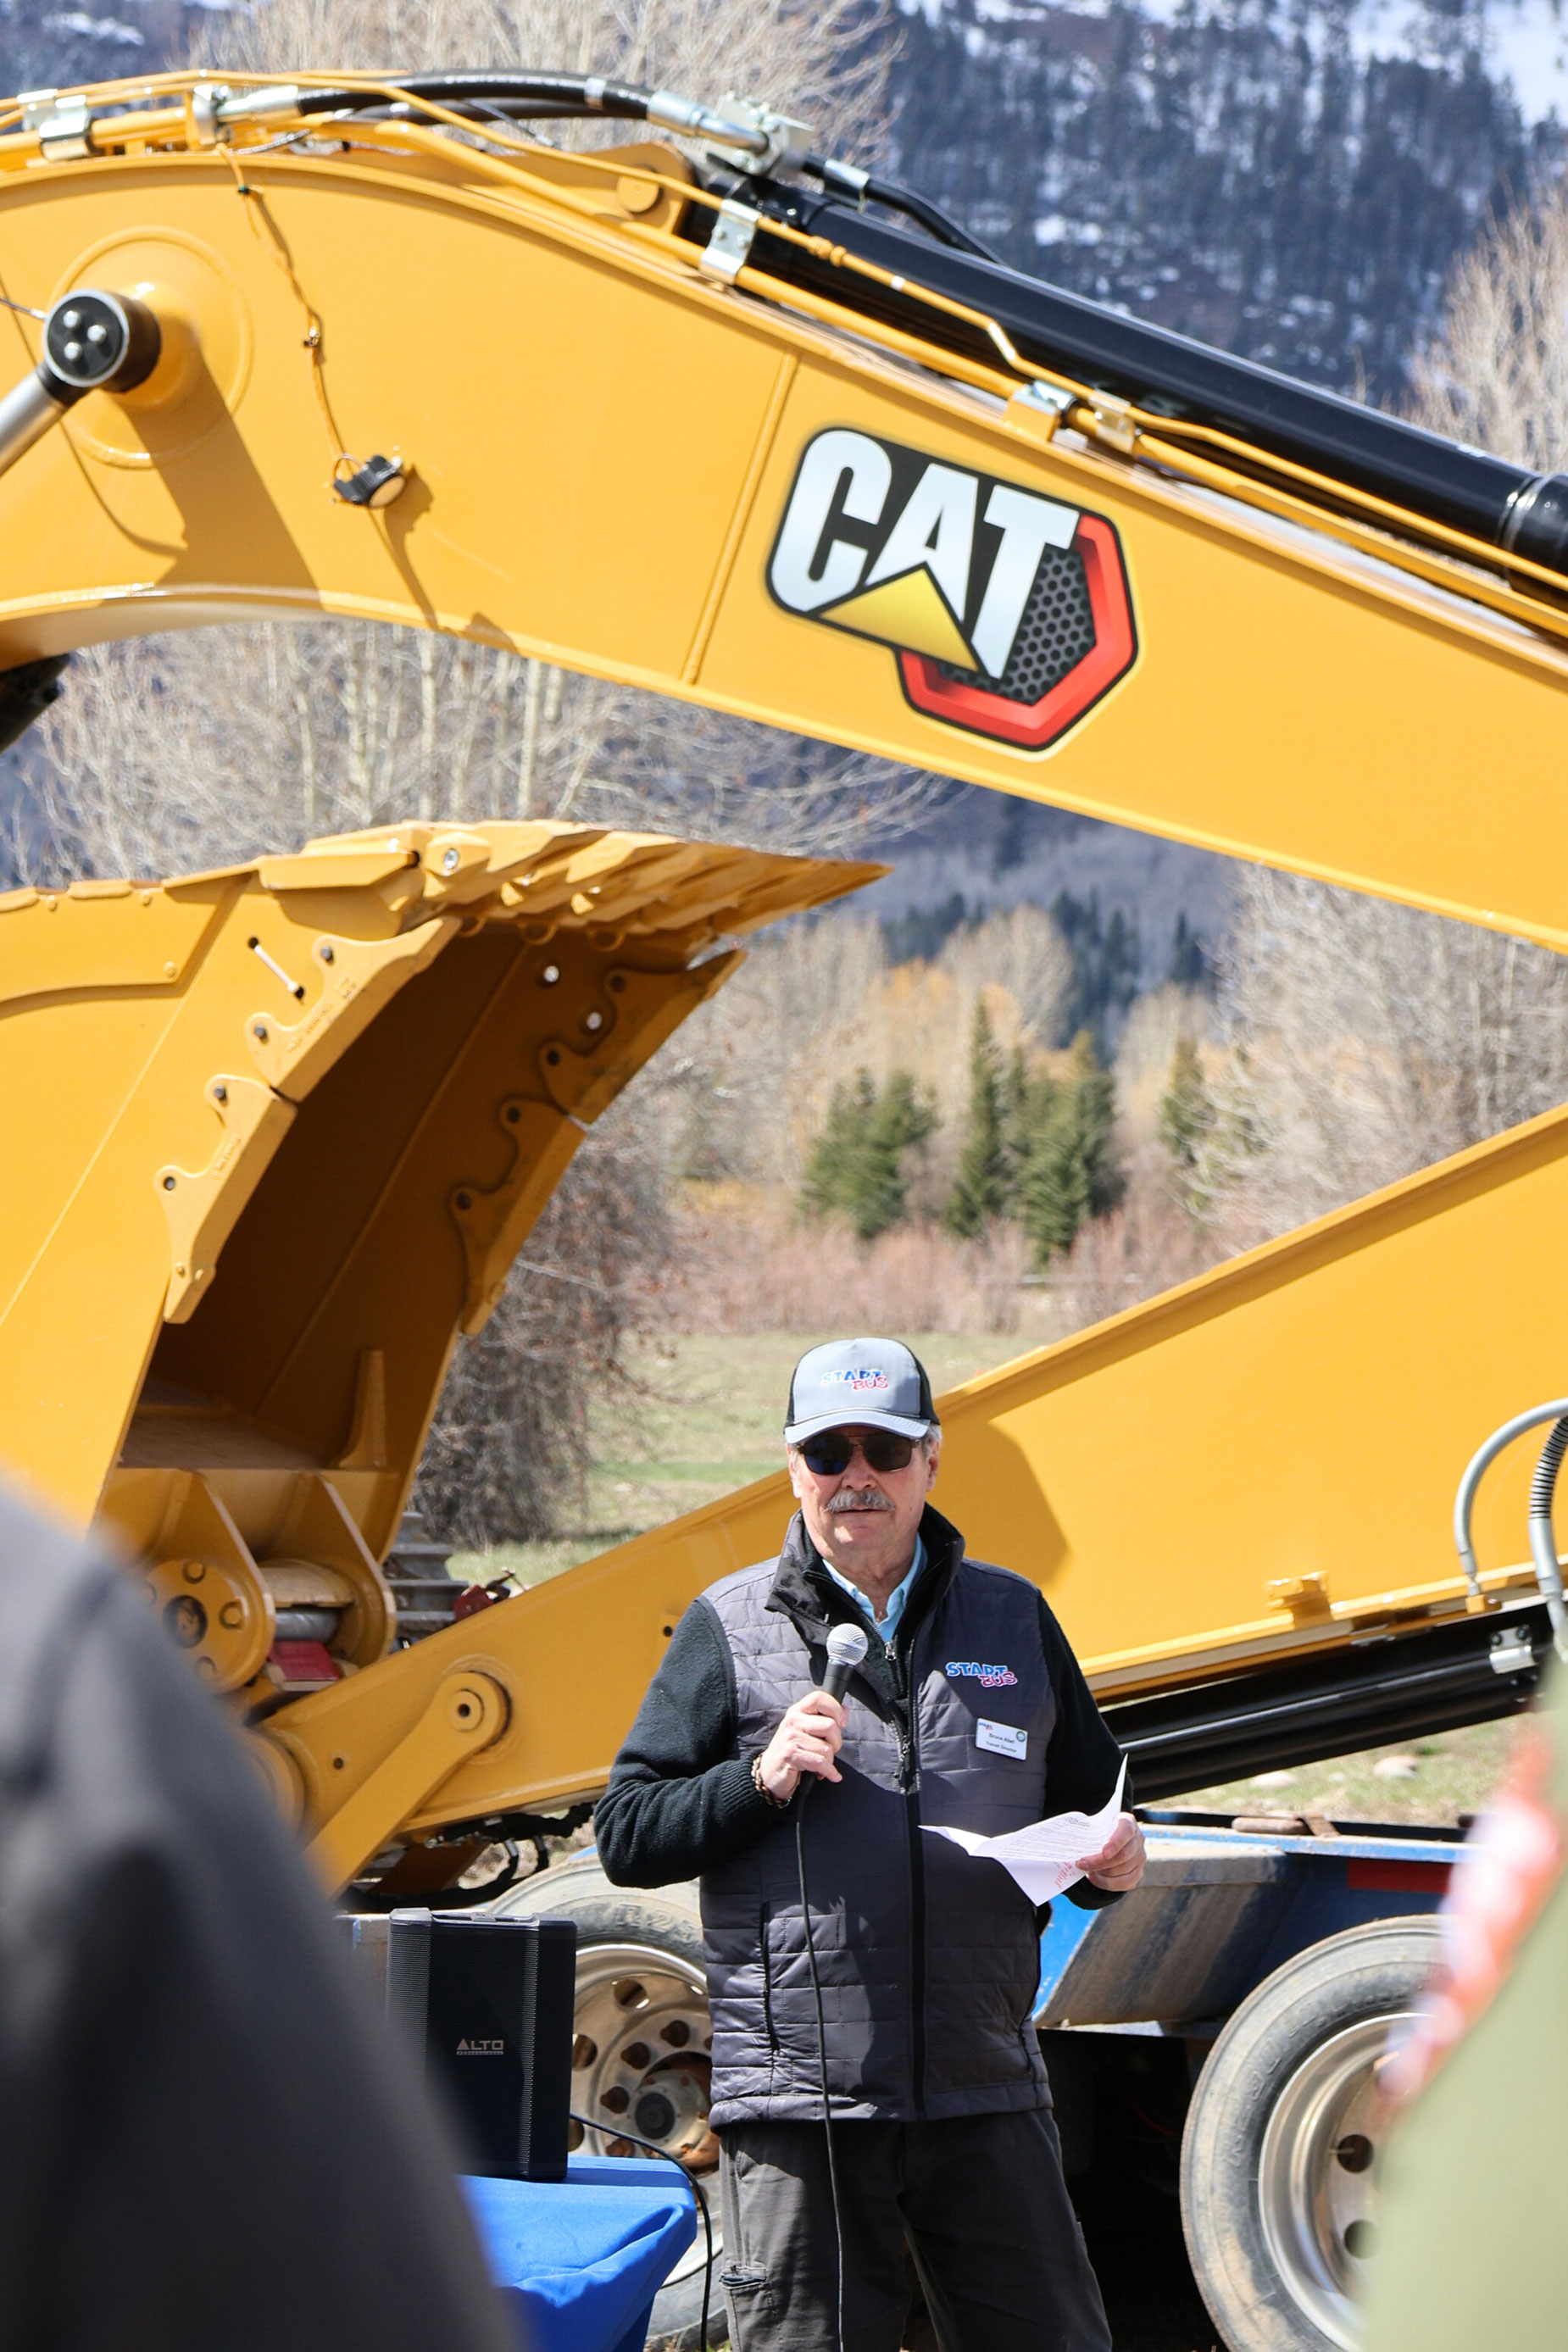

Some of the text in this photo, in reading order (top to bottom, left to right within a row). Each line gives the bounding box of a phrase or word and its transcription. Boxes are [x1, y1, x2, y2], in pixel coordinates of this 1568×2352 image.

[770, 430, 1080, 680] CAT
[820, 1370, 882, 1385] START
[851, 1376, 889, 1391] BUS
[946, 1661, 1009, 1677] START
[979, 1671, 1018, 1688] BUS
[456, 2038, 504, 2050] ALTO
